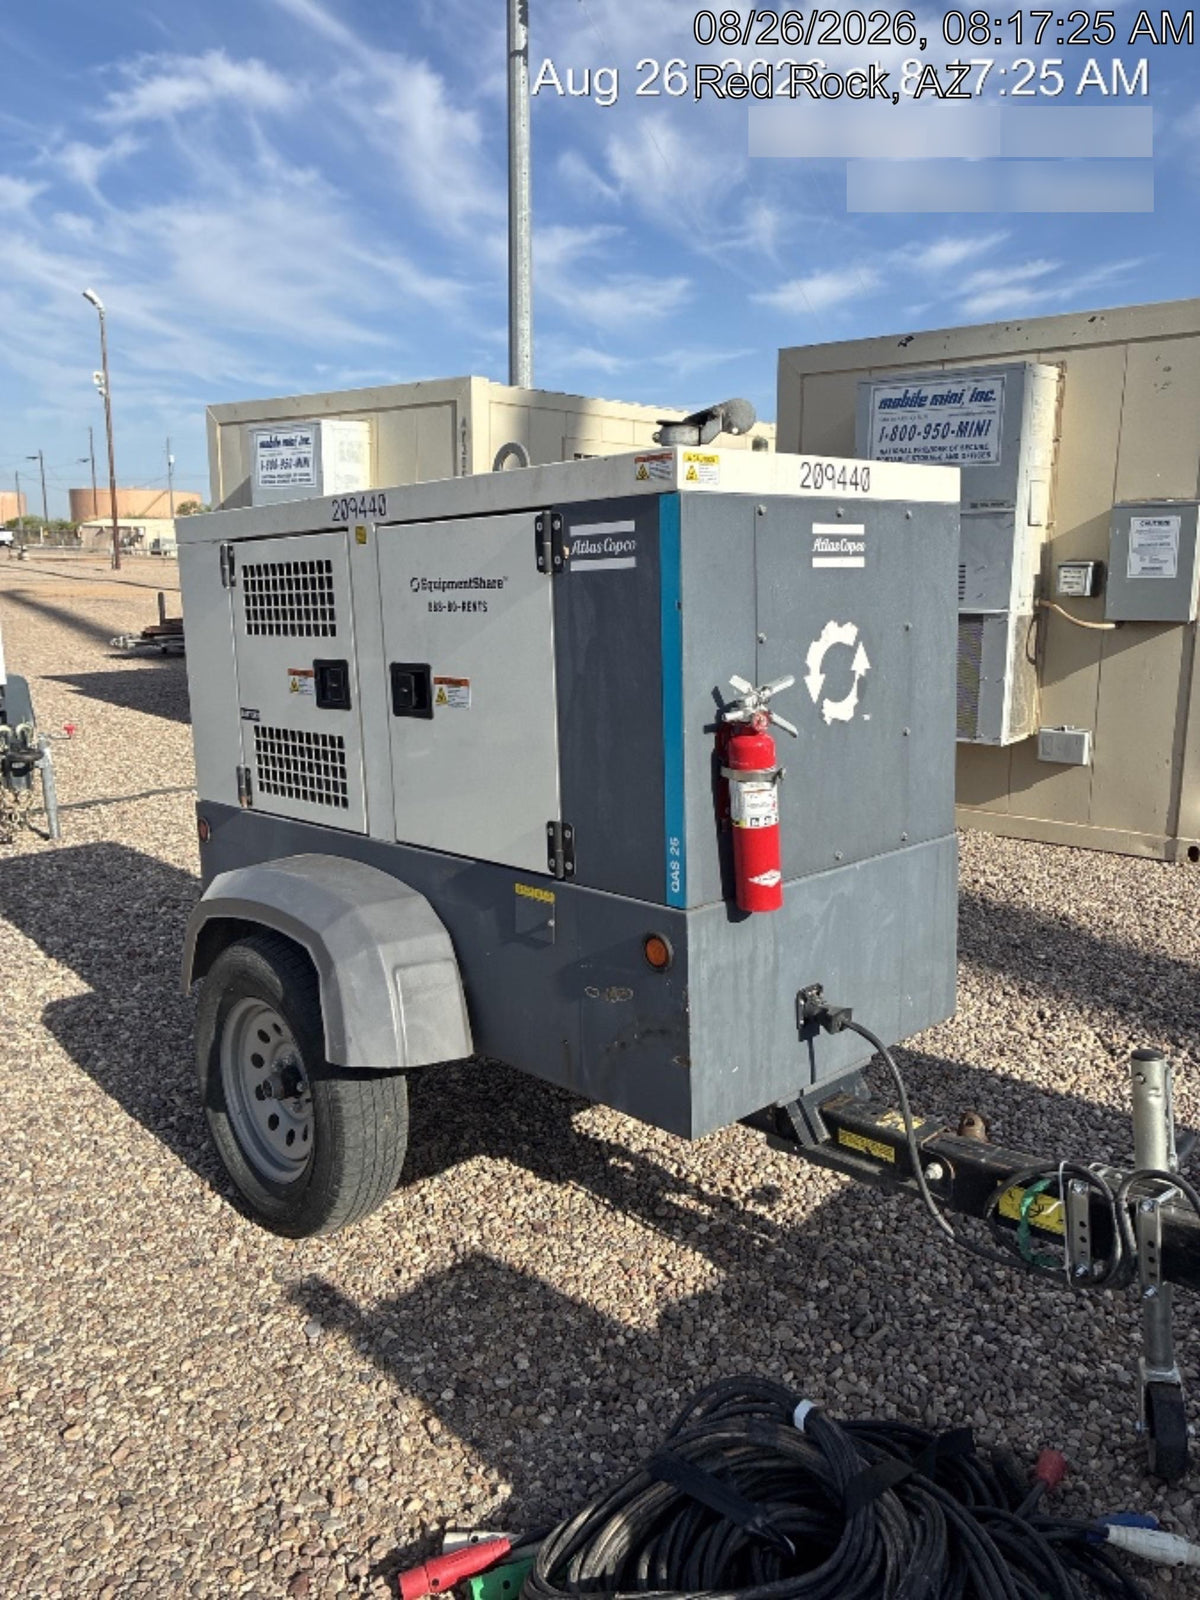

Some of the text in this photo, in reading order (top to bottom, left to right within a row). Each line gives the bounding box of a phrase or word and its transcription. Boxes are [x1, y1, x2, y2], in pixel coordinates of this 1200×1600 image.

[878, 419, 992, 443] 1-800-950-MINI
[800, 461, 871, 493] 209440
[332, 493, 387, 521] 209440
[571, 537, 637, 556] Atlas Copco
[812, 537, 840, 552] Atlas
[421, 577, 504, 592] EquipmentShare
